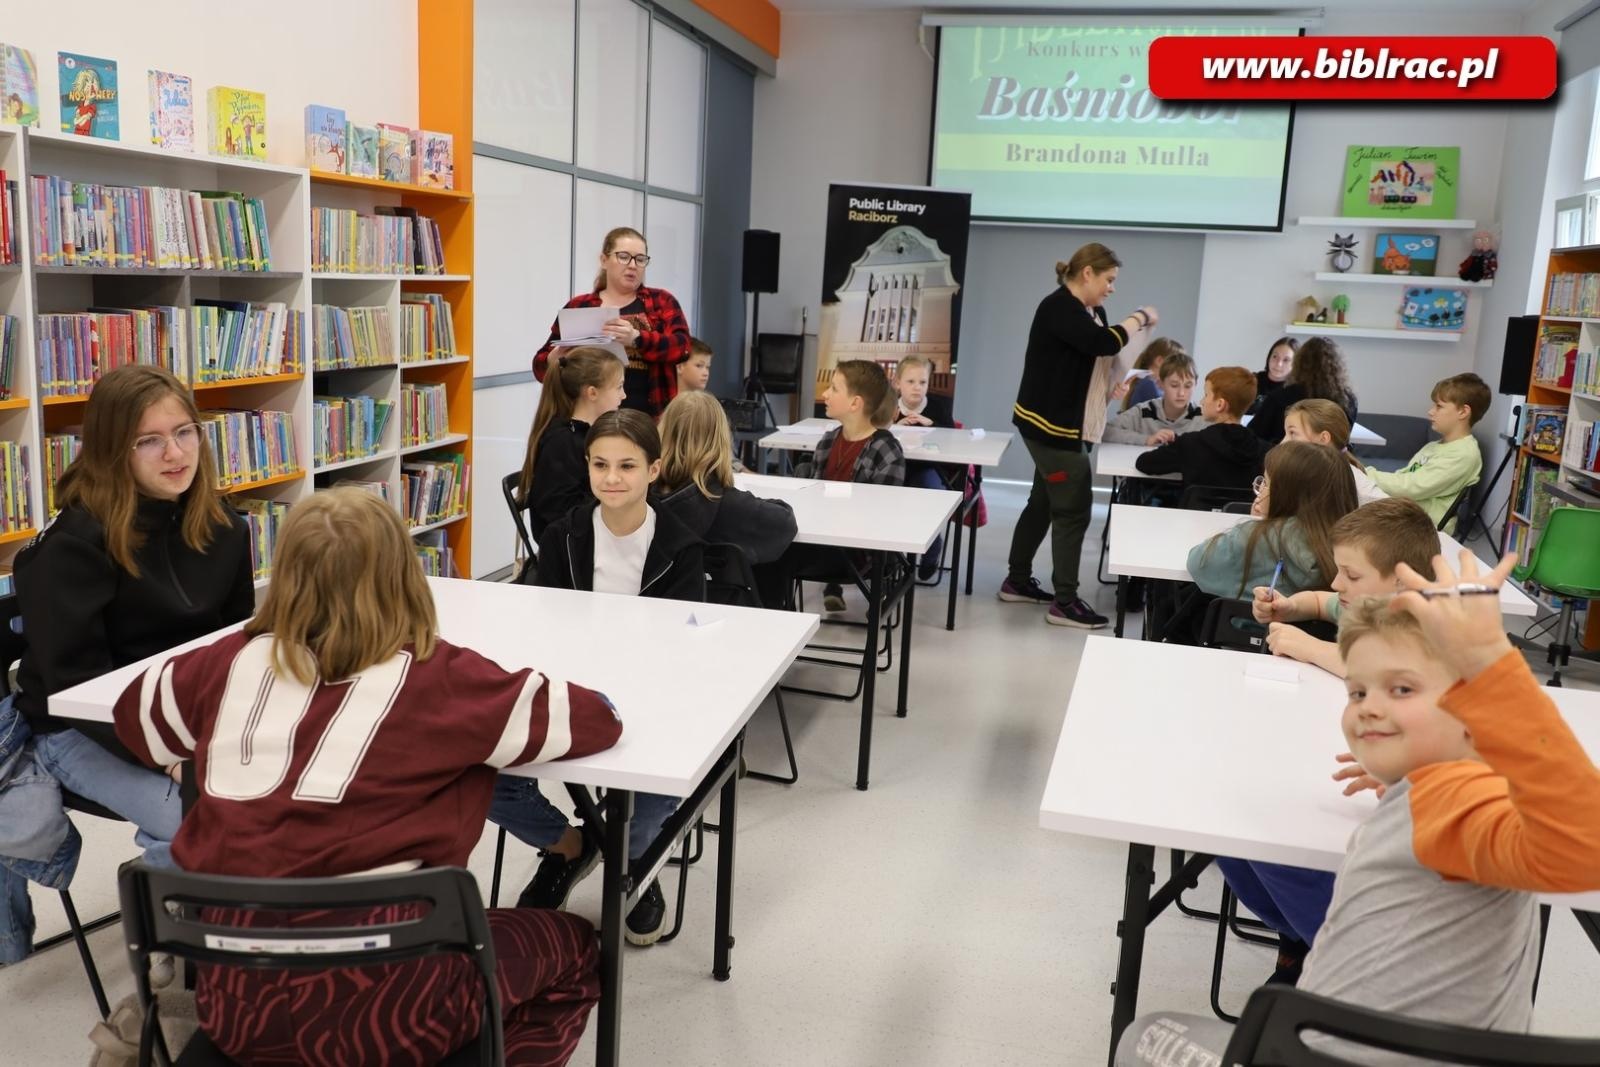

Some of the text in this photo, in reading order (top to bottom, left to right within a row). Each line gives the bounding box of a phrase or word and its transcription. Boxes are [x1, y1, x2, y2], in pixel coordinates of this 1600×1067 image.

[1026, 40, 1120, 57] Konkurs
[1005, 143, 1210, 167] Brandona Mulla
[1353, 147, 1392, 168] Julian
[849, 198, 926, 215] Public Library
[848, 210, 898, 223] Raciborz
